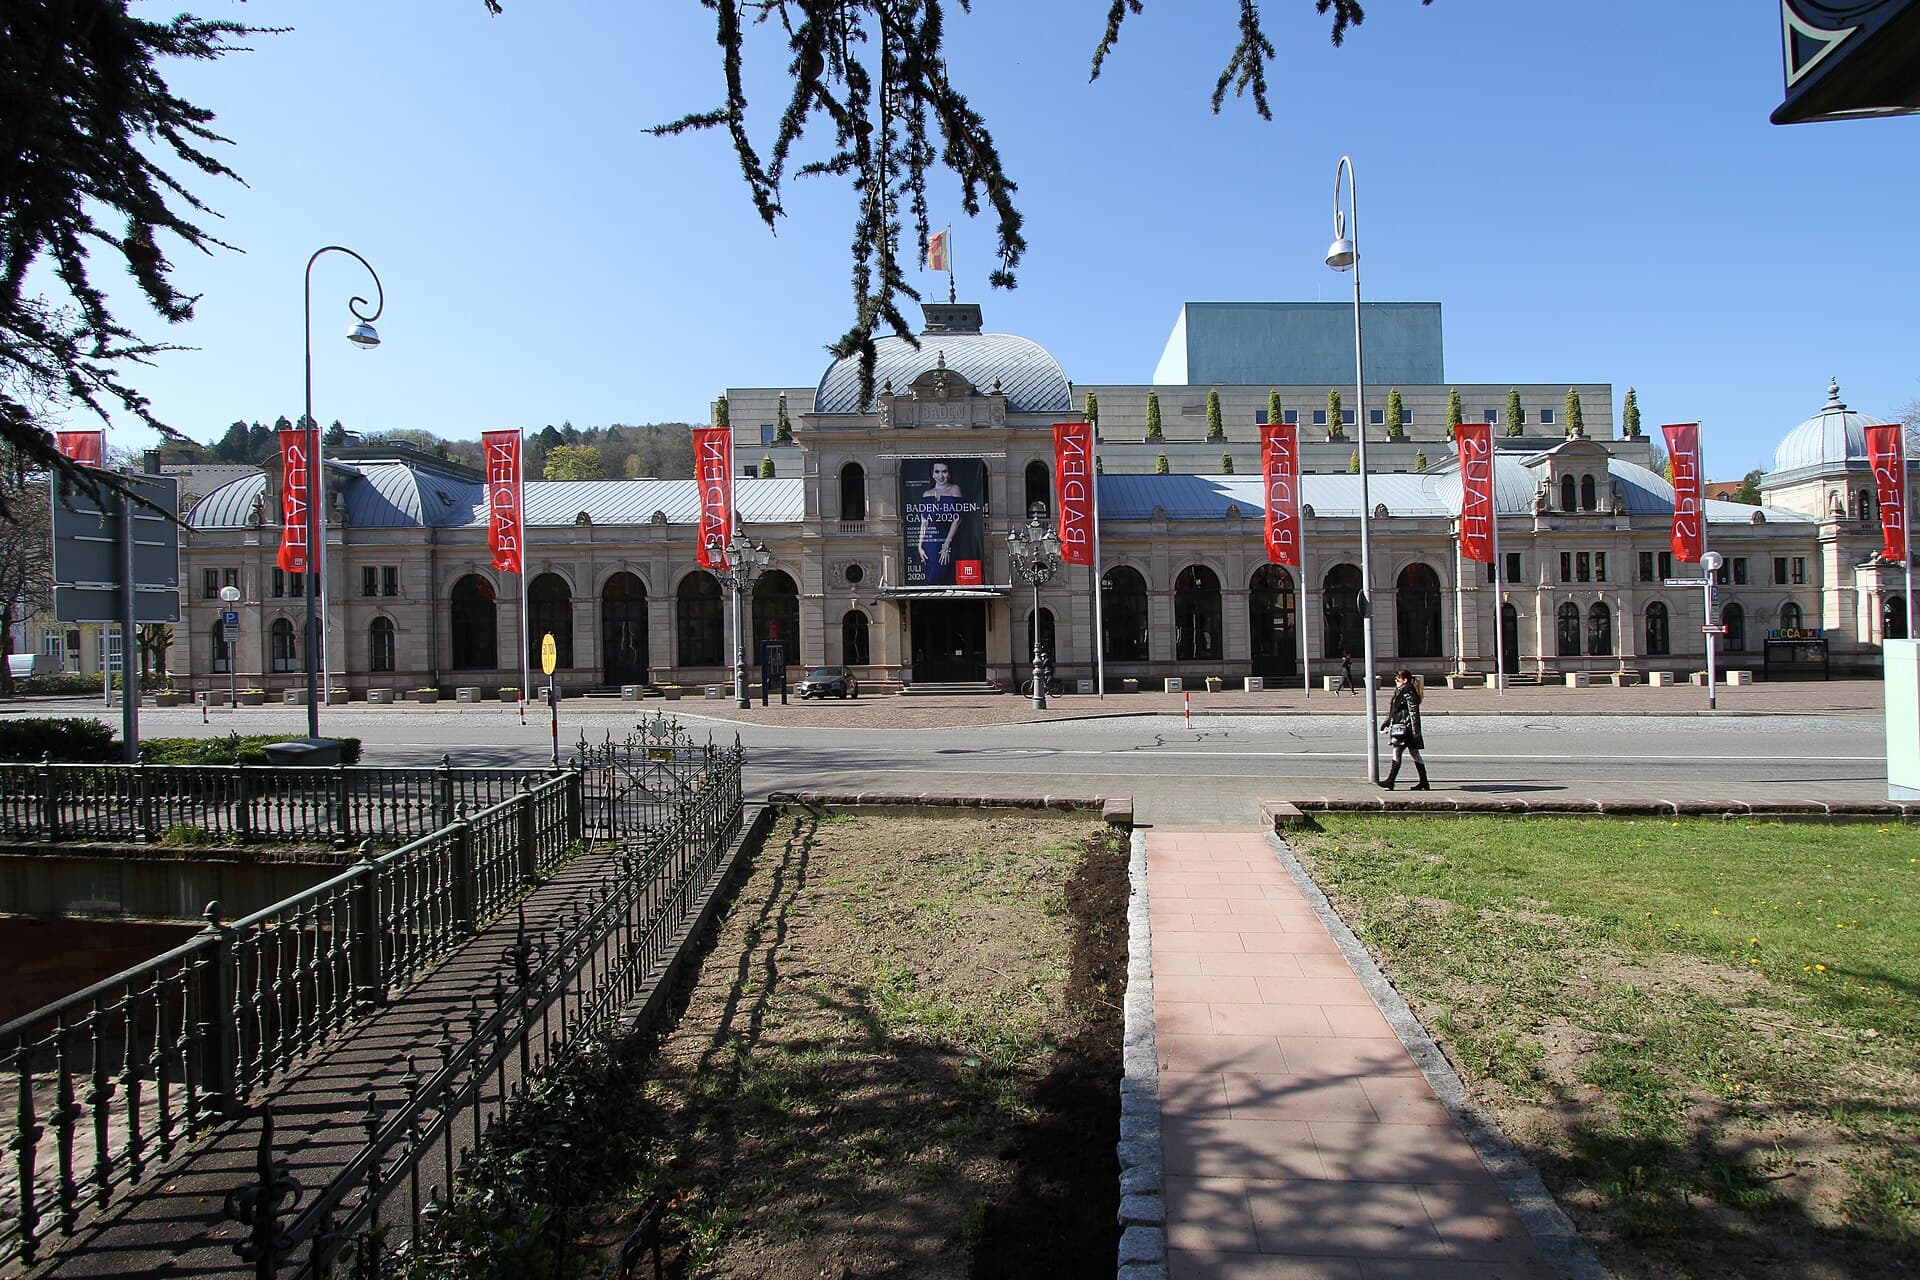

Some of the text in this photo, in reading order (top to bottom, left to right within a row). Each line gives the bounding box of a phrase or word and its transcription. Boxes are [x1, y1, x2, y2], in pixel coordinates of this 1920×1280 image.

[921, 405, 965, 420] BADEN
[906, 503, 980, 512] BADEN-BADEN-
[906, 513, 960, 523] GALA 2020
[907, 557, 913, 565] 5
[907, 565, 922, 573] JULI
[907, 573, 926, 581] 2020
